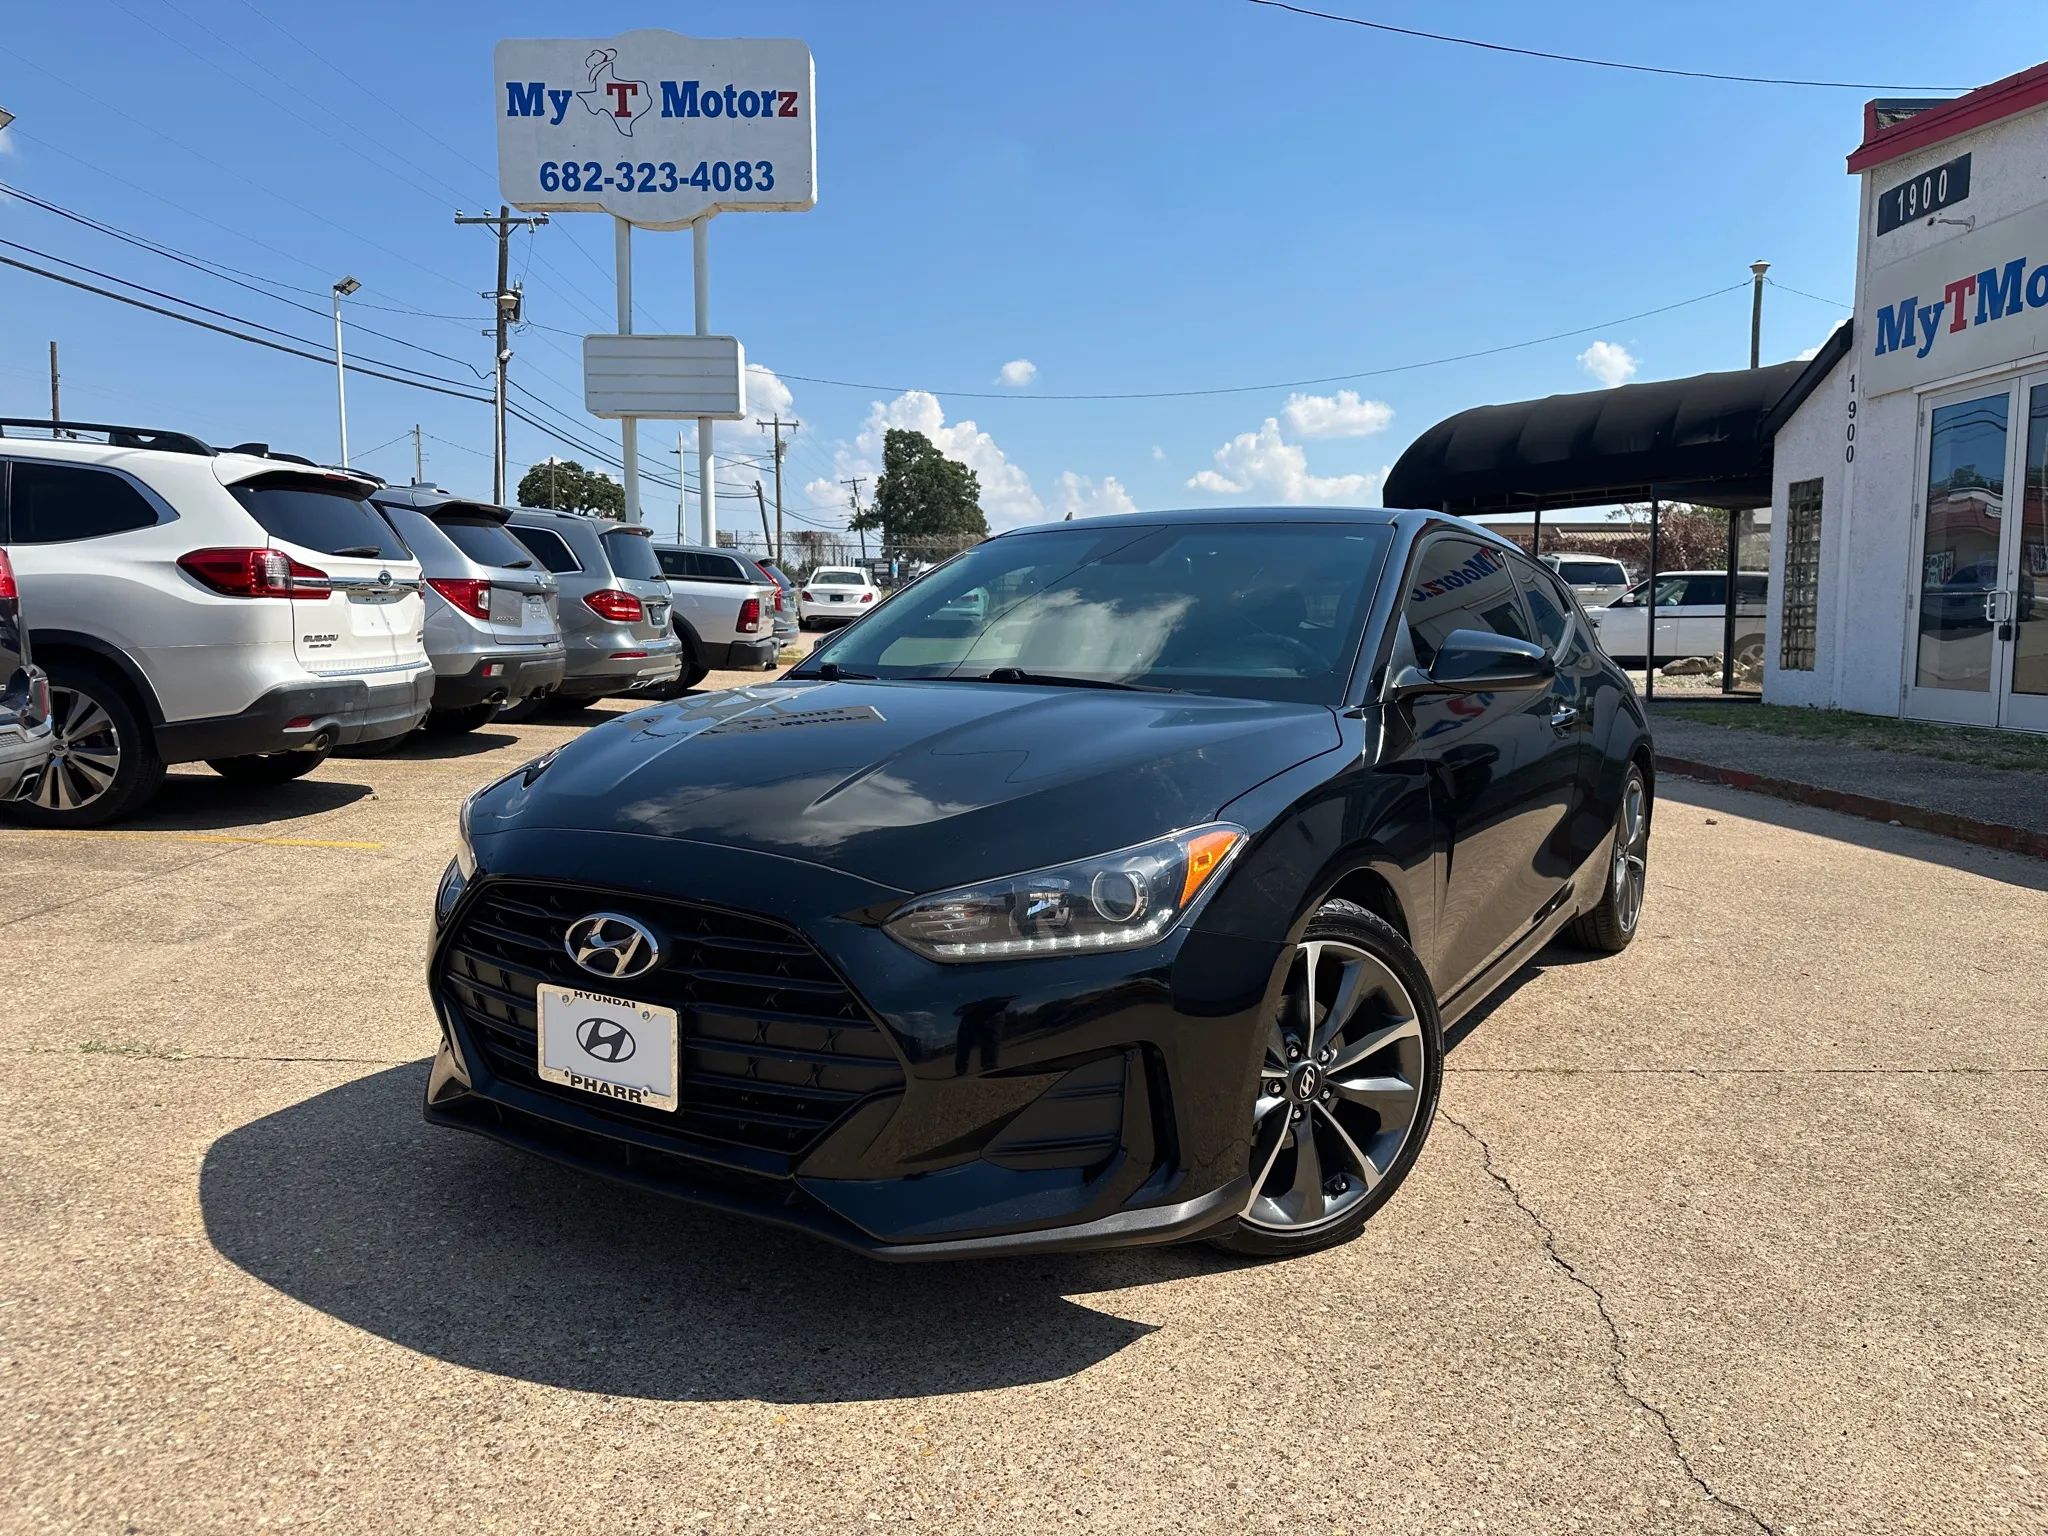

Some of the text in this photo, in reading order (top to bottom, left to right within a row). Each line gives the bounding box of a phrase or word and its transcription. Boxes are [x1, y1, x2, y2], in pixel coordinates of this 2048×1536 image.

[506, 80, 798, 125] My T Motorz
[539, 160, 775, 193] 682-323-4083
[1897, 169, 1948, 221] 1900
[1845, 374, 1857, 463] 1900
[574, 990, 636, 1009] HYUNDAI
[570, 1074, 642, 1103] PHARR
